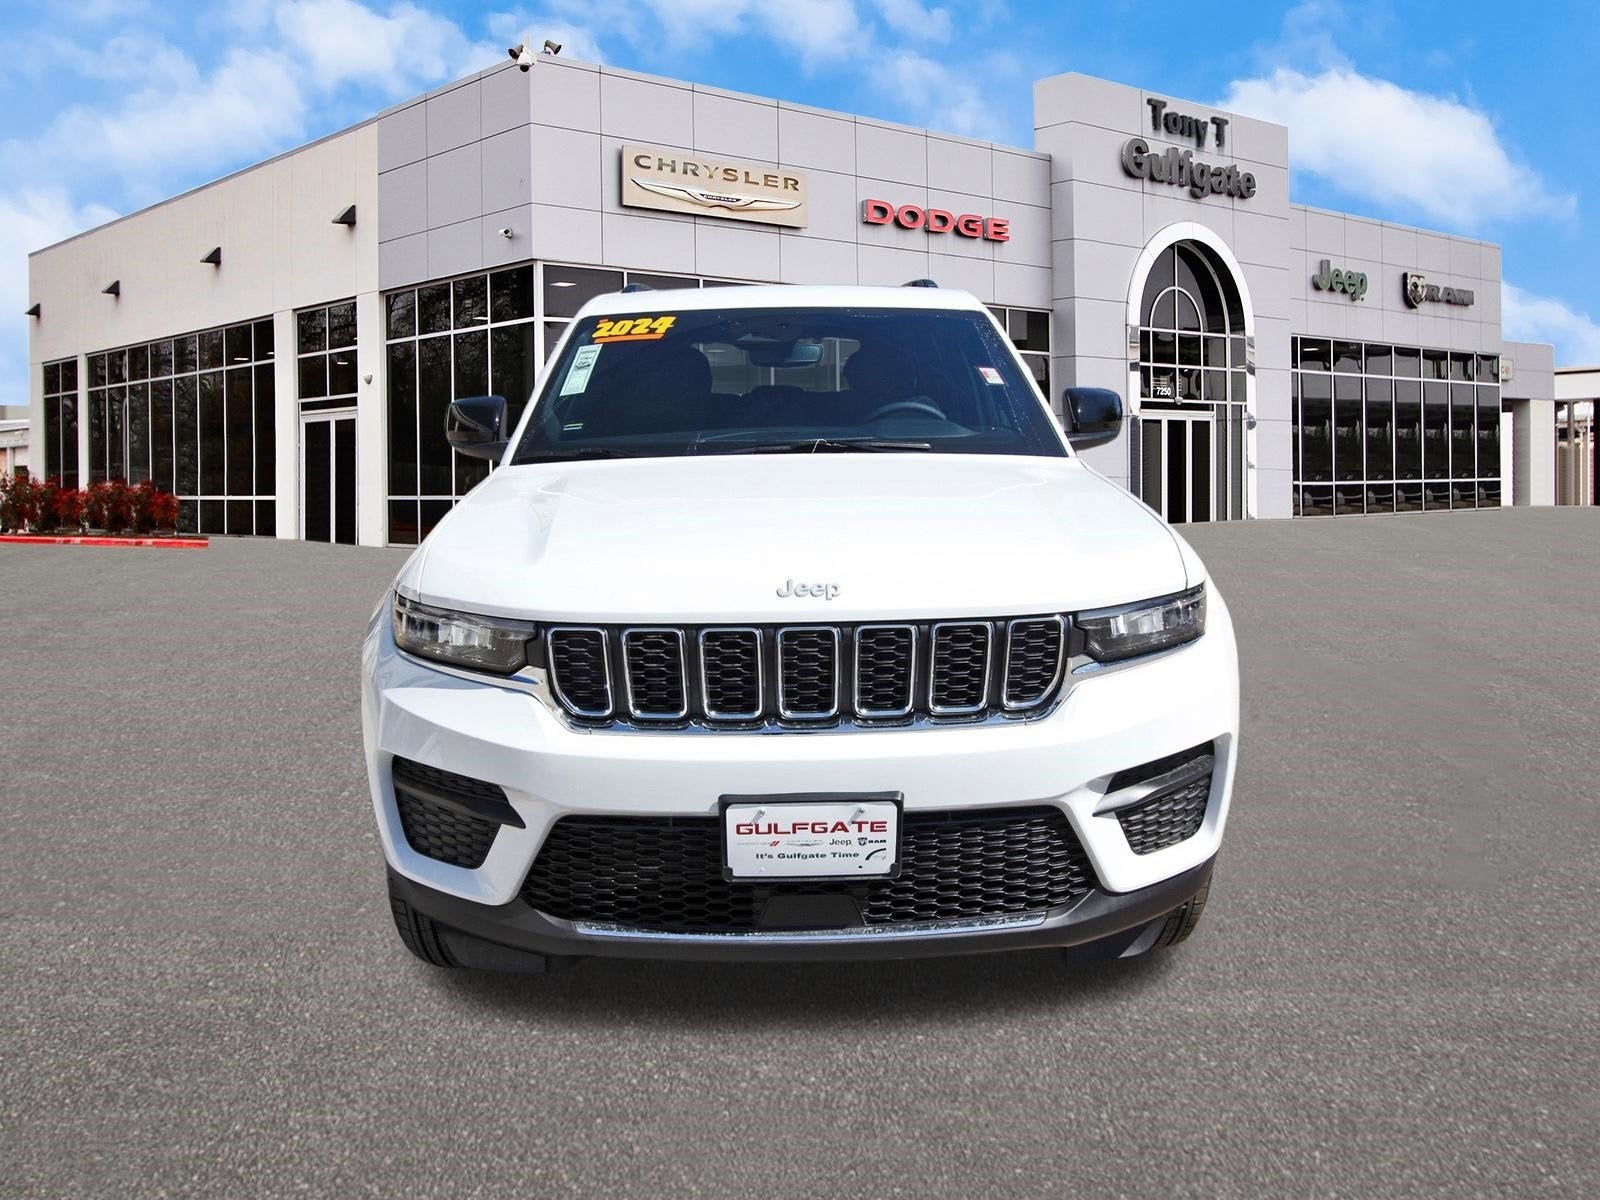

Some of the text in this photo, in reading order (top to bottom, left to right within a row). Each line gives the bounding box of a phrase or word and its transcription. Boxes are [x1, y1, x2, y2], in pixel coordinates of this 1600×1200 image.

[1146, 98, 1229, 147] Tony T
[633, 154, 800, 192] CHRYSLER
[1121, 138, 1256, 199] Gulfgate
[862, 198, 1010, 242] DODGE
[1312, 259, 1368, 301] Jeep
[1424, 284, 1475, 306] RAM
[591, 316, 677, 338] 2024
[776, 579, 841, 601] Jeep
[735, 820, 888, 835] GULFGATE
[829, 838, 852, 846] Jeep
